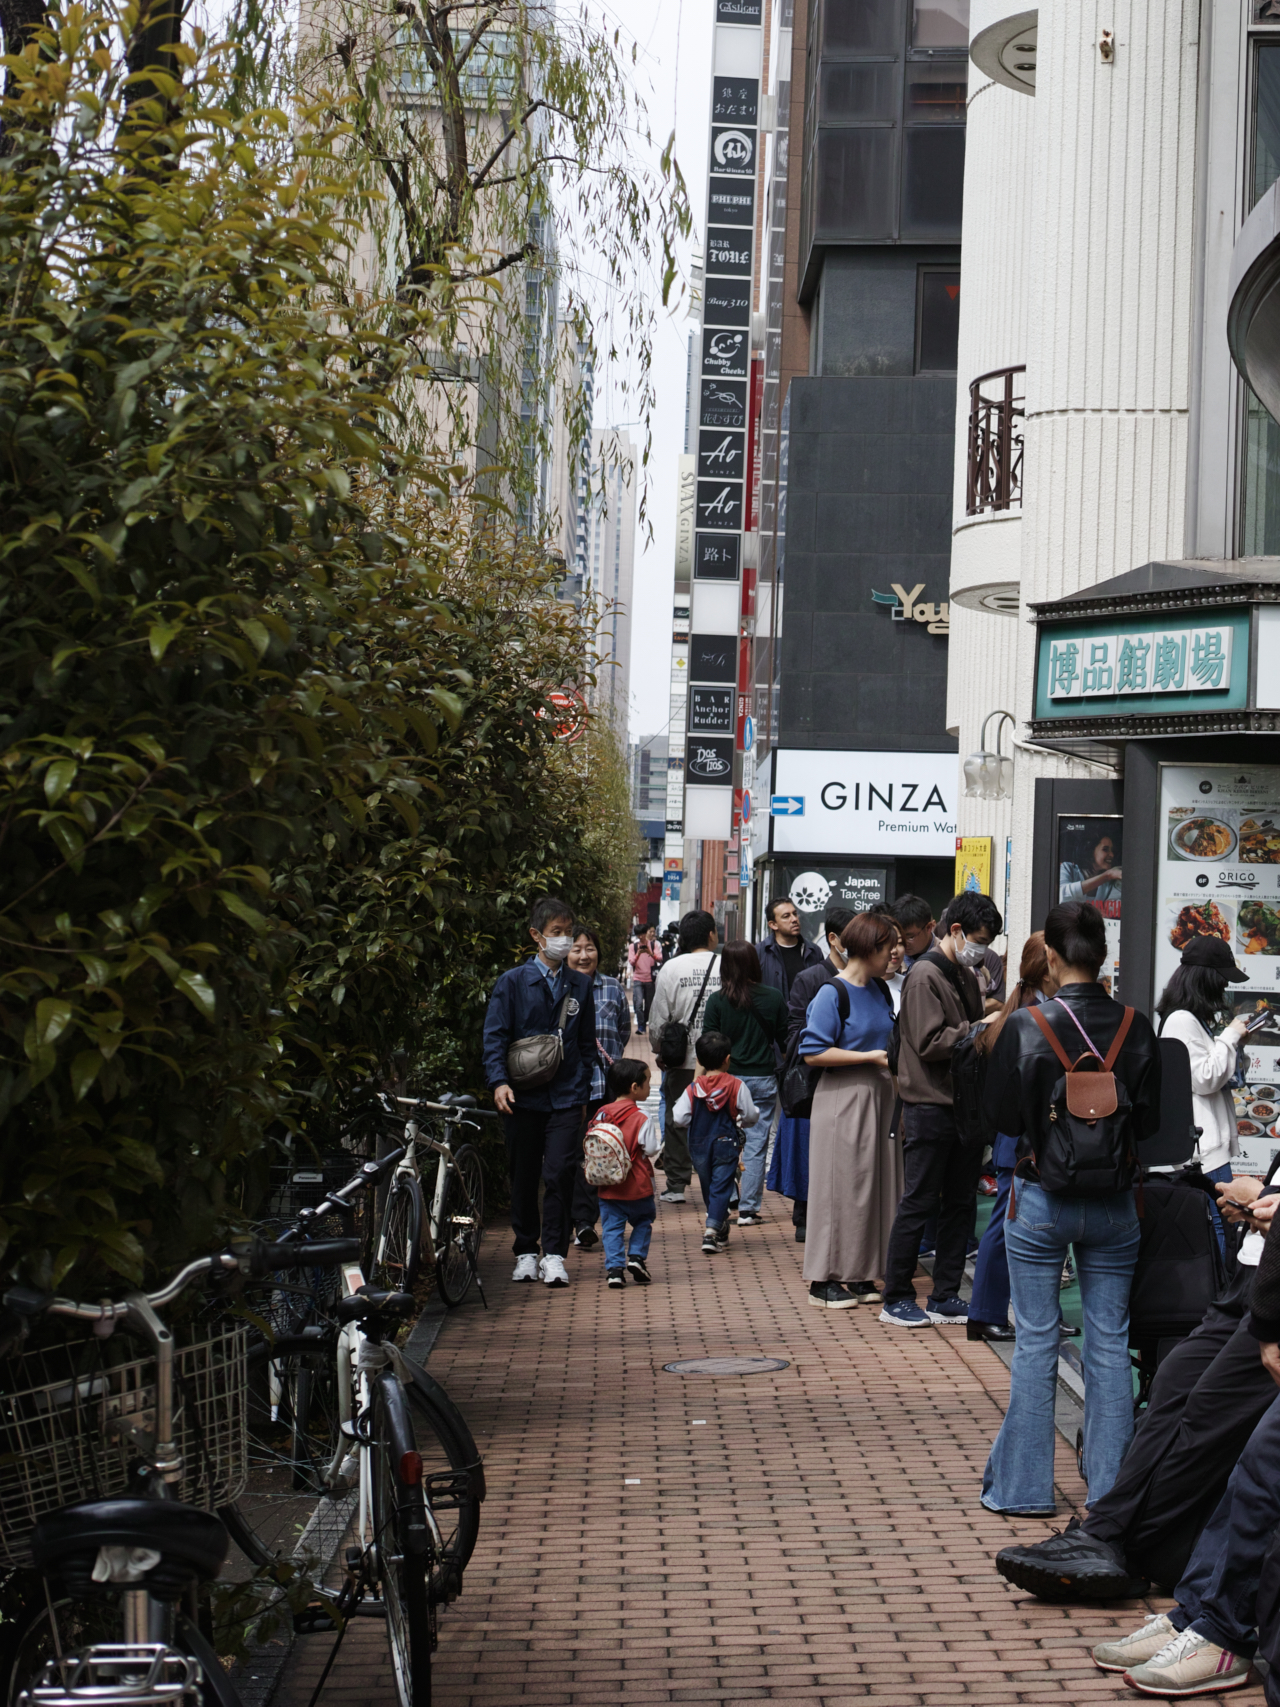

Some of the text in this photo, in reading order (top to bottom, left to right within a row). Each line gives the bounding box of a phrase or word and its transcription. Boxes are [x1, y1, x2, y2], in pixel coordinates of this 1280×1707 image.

[719, 2, 760, 14] GASLIGHT
[714, 103, 757, 116] おだまり
[706, 297, 748, 308] Bay 310
[704, 357, 731, 367] Chubby
[720, 367, 745, 375] Cheeks
[679, 518, 690, 564] GINZA
[1050, 631, 1226, 696] 博品館劇場
[694, 705, 730, 713] Anchor
[694, 716, 730, 725] Rudder
[820, 781, 948, 813] GINZA
[878, 820, 929, 833] Premium
[844, 875, 881, 889] Japan.
[1218, 871, 1256, 881] ORIGO
[840, 888, 881, 900] Tax-free
[679, 977, 702, 988] SPACE
